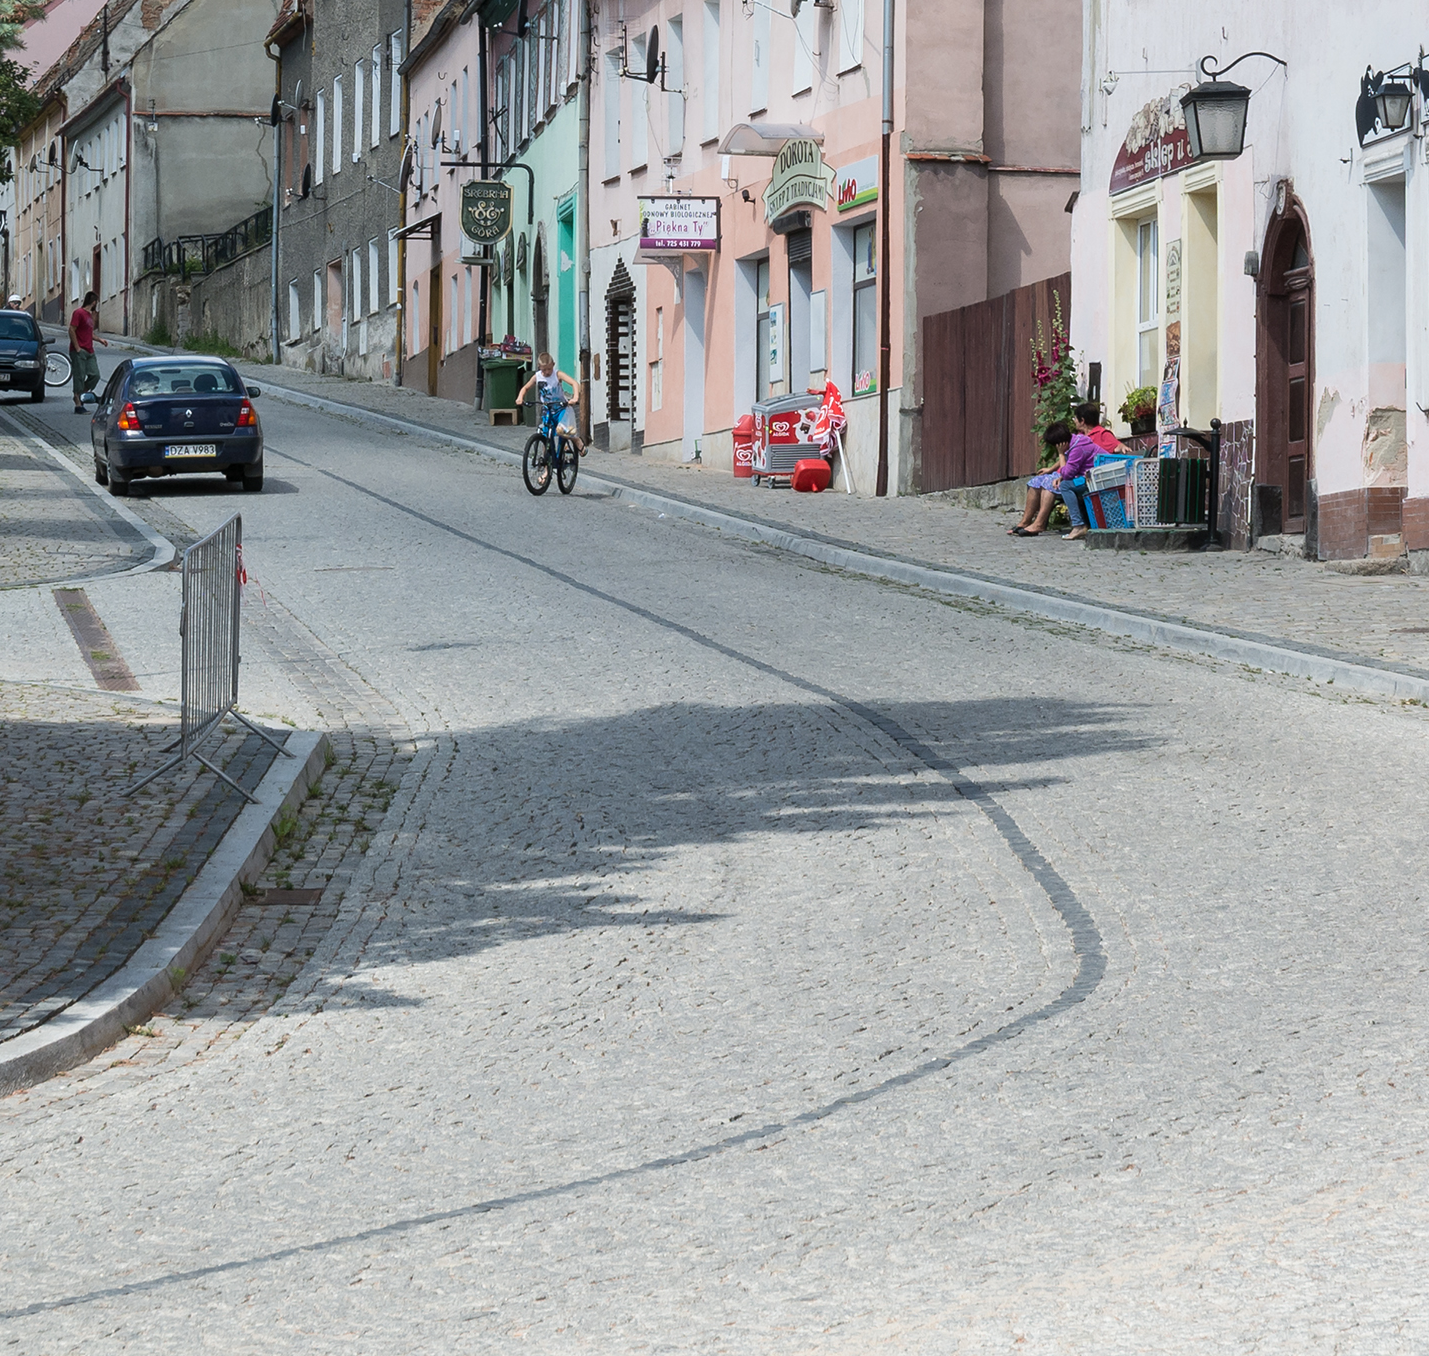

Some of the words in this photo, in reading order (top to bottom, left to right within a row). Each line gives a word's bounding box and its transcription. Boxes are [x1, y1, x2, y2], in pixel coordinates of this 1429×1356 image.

[780, 140, 814, 175] DOROTA
[1144, 138, 1174, 173] sklep
[1177, 139, 1185, 160] u
[464, 189, 509, 199] SREBRNA
[769, 190, 786, 217] SKLEP
[790, 181, 824, 201] TRADYCJAMI
[471, 225, 500, 238] GÓRA
[171, 446, 190, 455] DZA
[192, 445, 215, 455] V983
